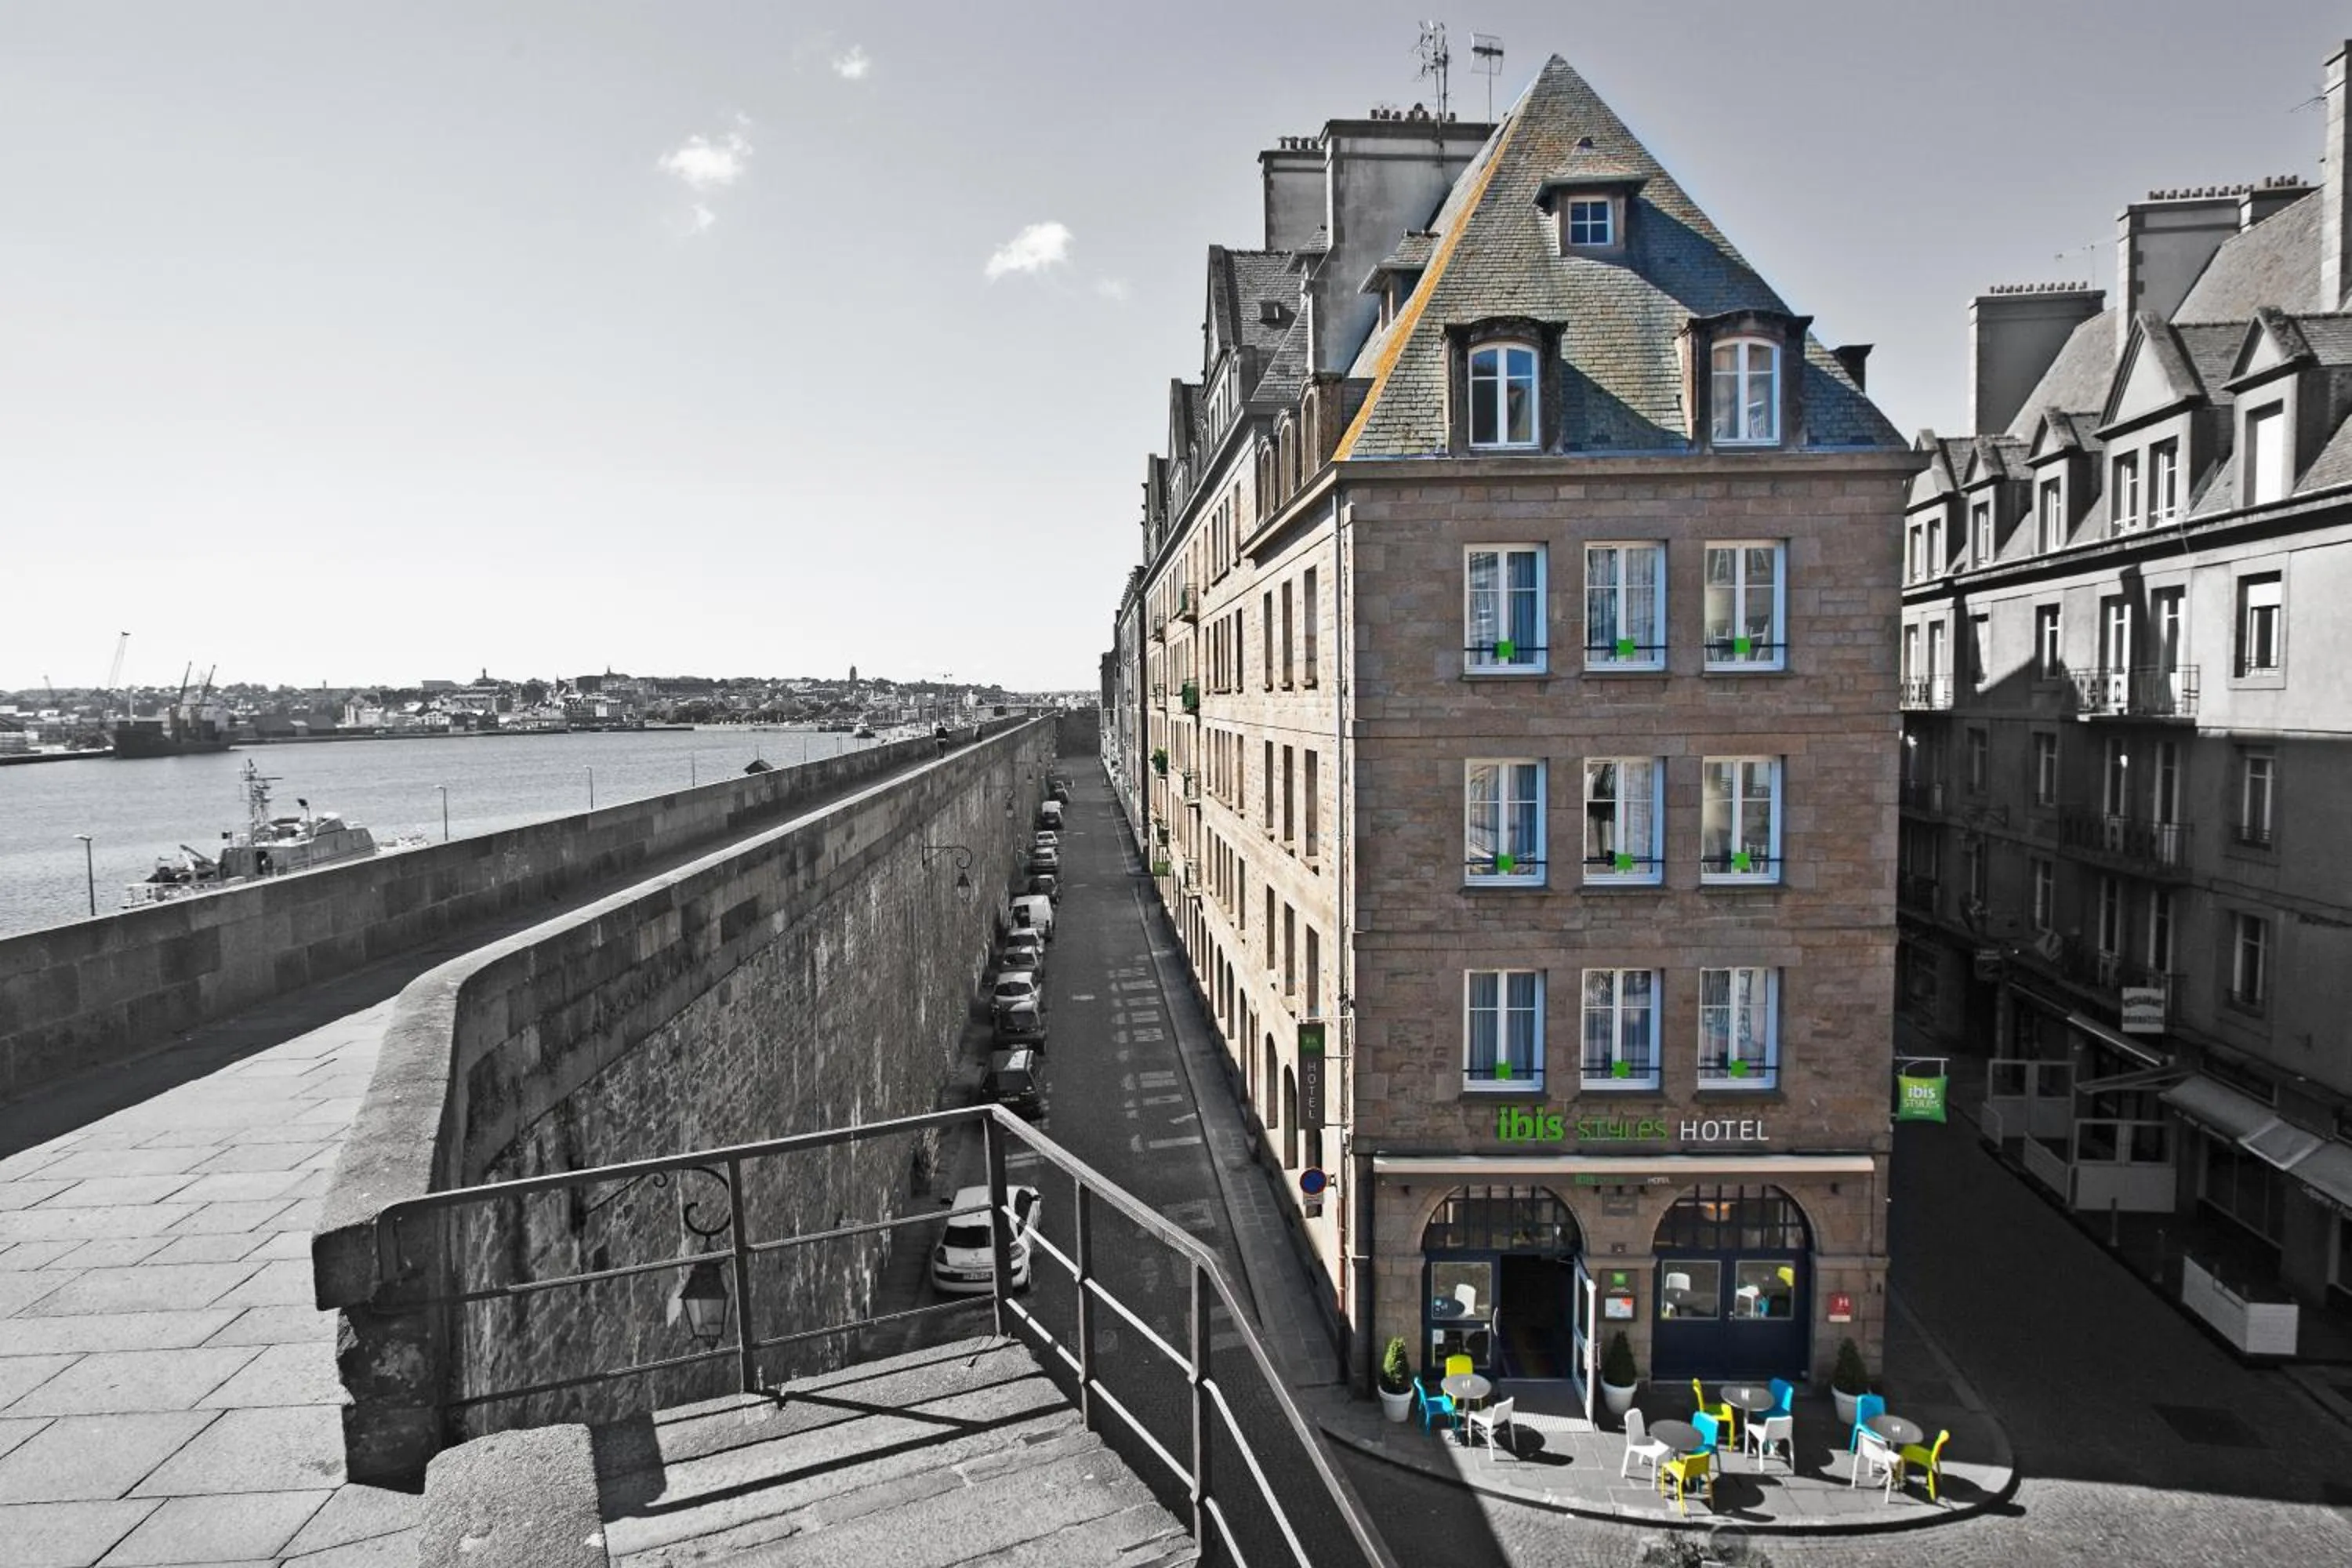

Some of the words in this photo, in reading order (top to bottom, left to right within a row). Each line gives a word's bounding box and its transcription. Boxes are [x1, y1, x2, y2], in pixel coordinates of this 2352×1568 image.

[1307, 1061, 1317, 1120] HOTEL
[1907, 1084, 1936, 1098] ibis
[1499, 1105, 1564, 1142] ibis
[1680, 1120, 1769, 1141] HOTEL
